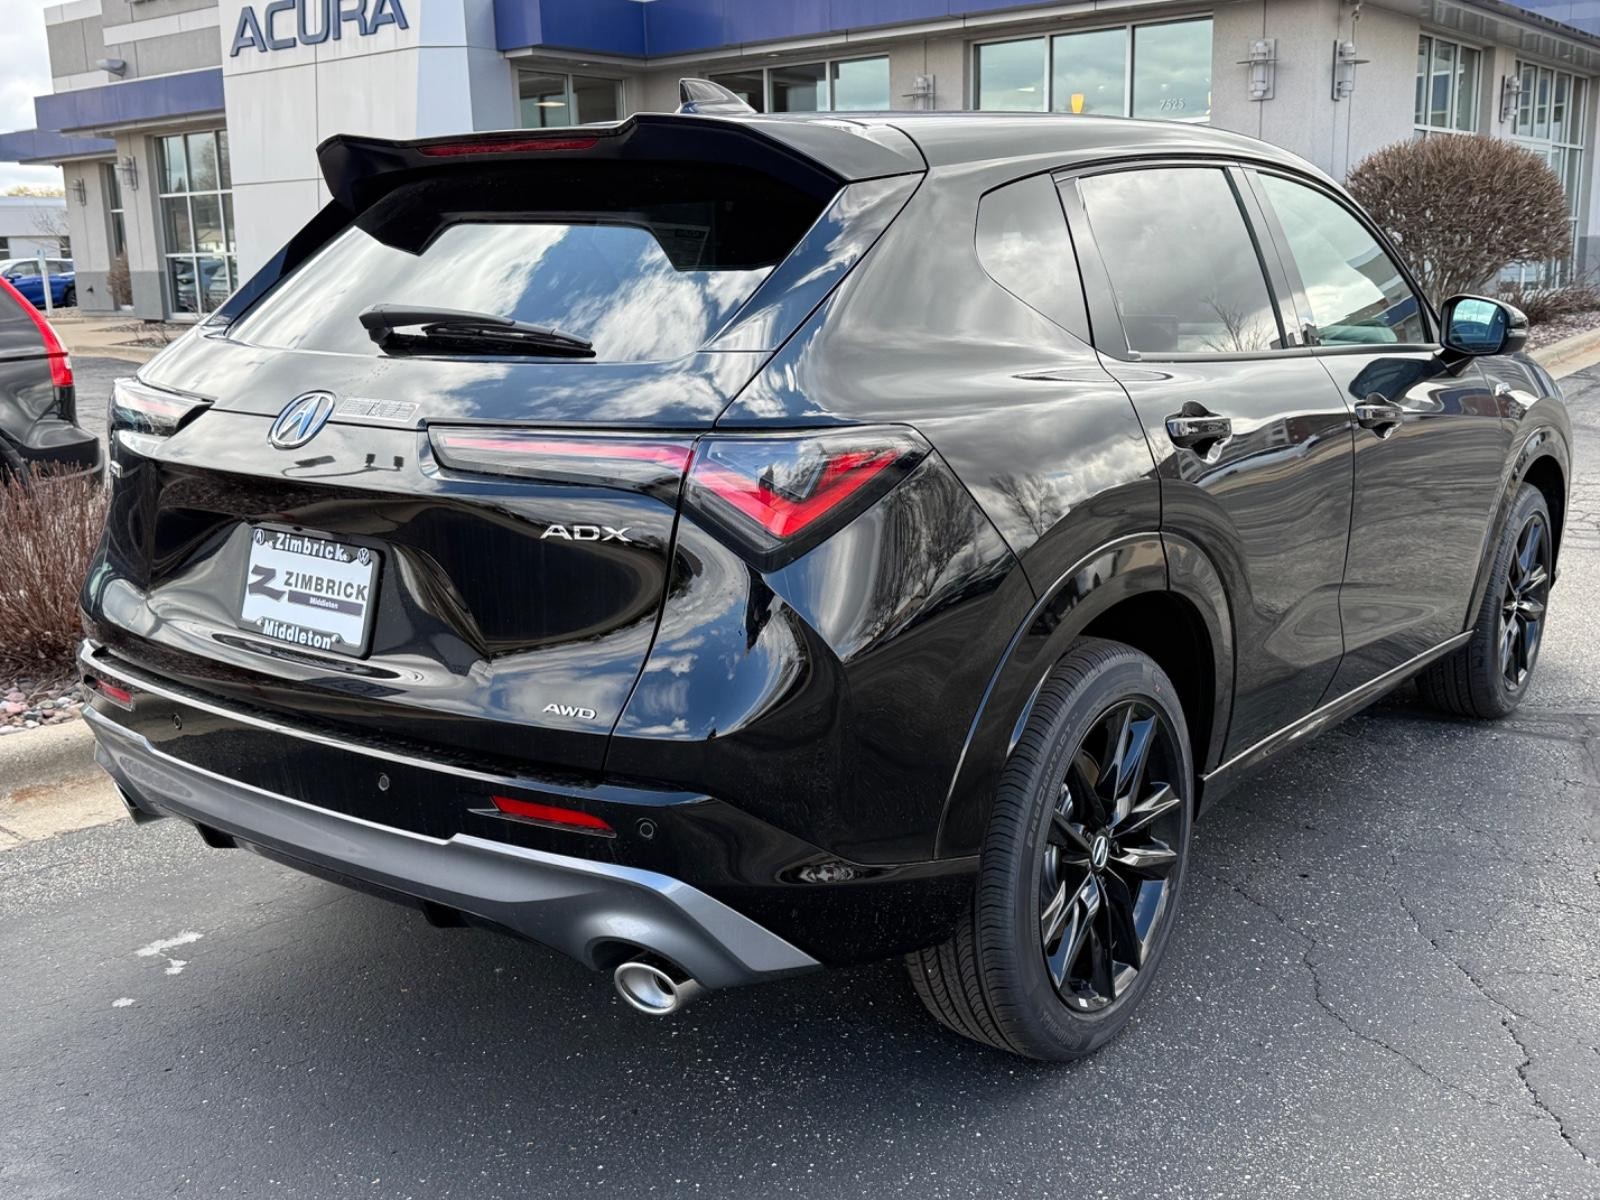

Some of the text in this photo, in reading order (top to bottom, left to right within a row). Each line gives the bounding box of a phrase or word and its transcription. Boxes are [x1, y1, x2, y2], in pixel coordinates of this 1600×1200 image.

[229, 0, 409, 57] ACURA
[276, 532, 345, 560] Zimbrick
[540, 524, 633, 543] ADX
[284, 570, 368, 602] ZIMBRICK
[309, 596, 339, 610] Middleton
[262, 619, 332, 650] Middleton
[542, 703, 597, 720] AWD
